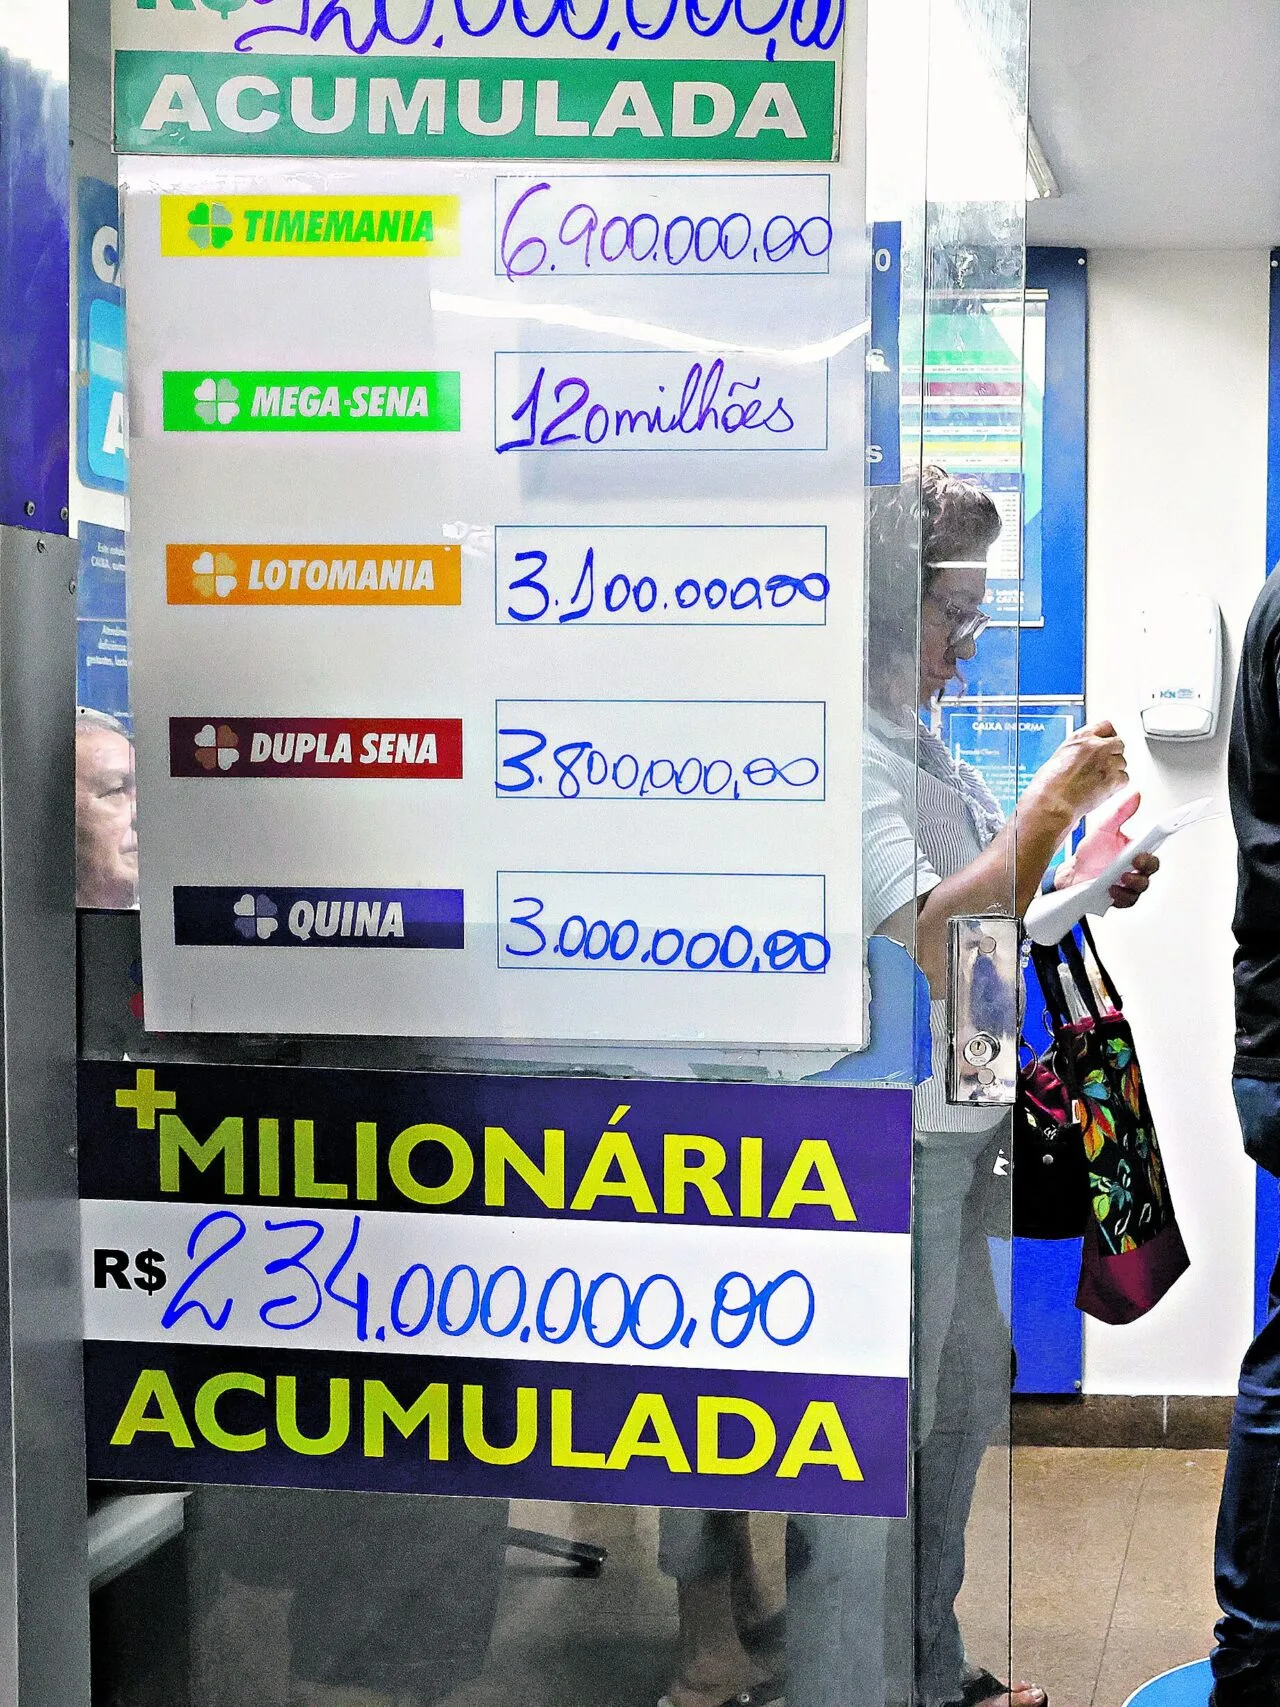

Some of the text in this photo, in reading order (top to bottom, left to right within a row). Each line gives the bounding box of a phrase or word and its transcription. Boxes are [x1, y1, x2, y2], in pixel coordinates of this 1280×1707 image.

[140, 74, 809, 138] ACUMULADA
[244, 210, 434, 242] TIMEMANIA
[250, 386, 429, 417] MEGA-SENA
[249, 556, 435, 592] LOTOMANIA
[971, 722, 1003, 732] CAIXA
[250, 732, 438, 765] DUPLA SENA
[288, 902, 406, 938] QUINA
[506, 896, 831, 972] 3.000.000,00
[93, 1210, 815, 1350] R$ 234.000.000,00
[110, 1370, 865, 1481] ACUMULADA
